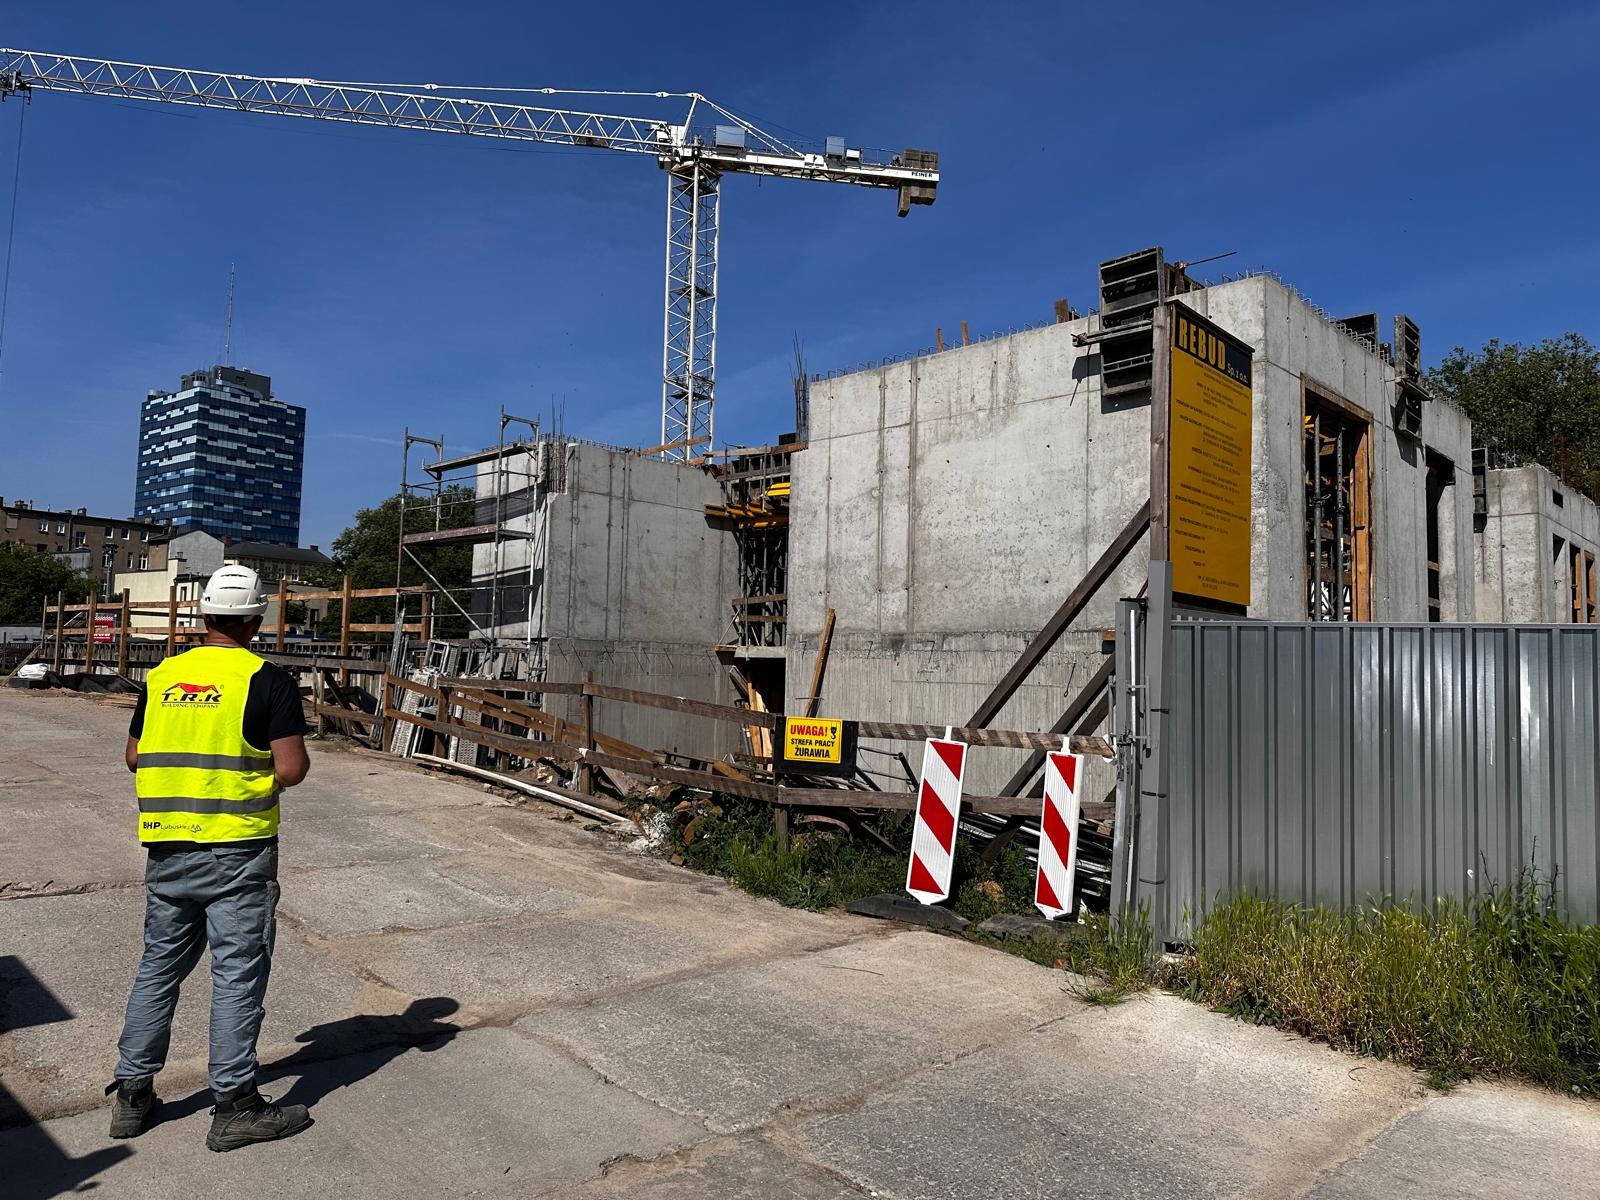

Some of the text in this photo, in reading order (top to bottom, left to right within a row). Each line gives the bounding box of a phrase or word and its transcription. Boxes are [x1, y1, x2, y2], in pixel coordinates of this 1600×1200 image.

[1179, 318, 1226, 370] REBUD
[162, 693, 222, 702] T.R.K
[790, 724, 828, 737] UWAGA!
[790, 738, 835, 747] STREFA PRACY
[794, 745, 831, 758] ŻURAWIA
[143, 821, 161, 830] BHP
